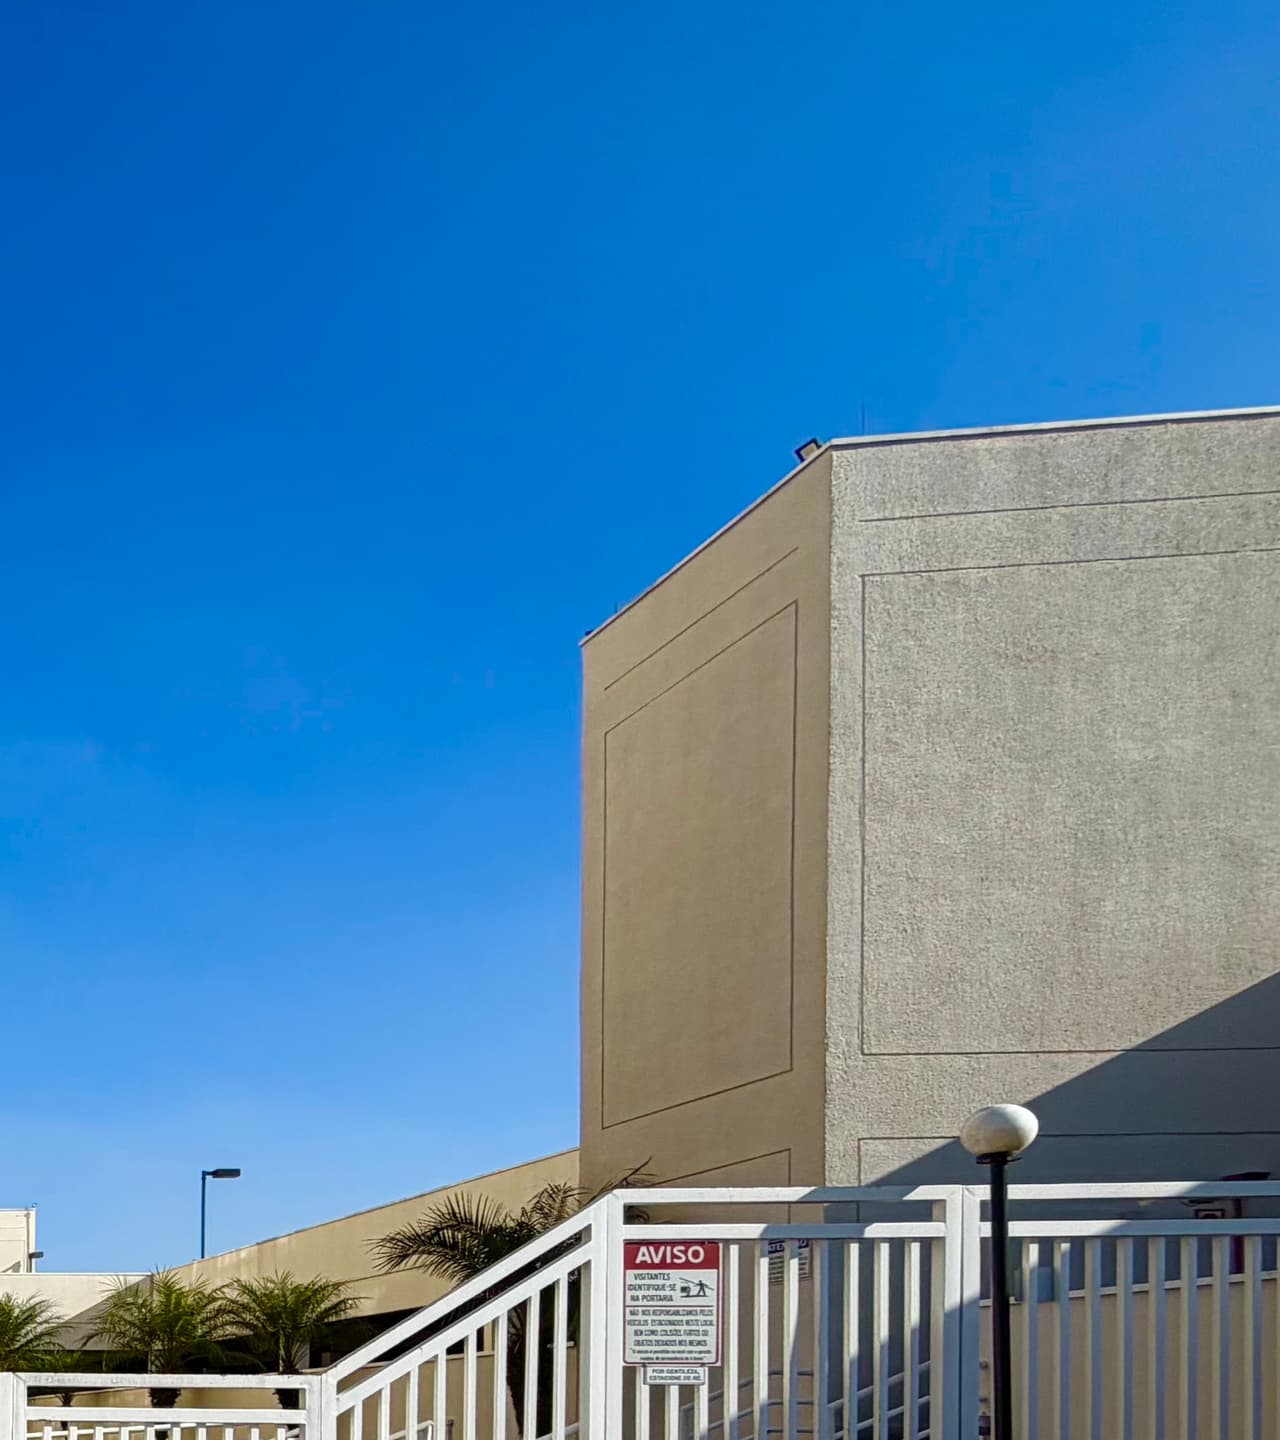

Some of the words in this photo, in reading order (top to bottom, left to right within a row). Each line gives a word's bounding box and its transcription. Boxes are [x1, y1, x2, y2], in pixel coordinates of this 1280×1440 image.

[635, 1245, 705, 1264] AVISO
[633, 1272, 671, 1280] VISITANTES
[627, 1283, 677, 1292] IDENTIFIQUE-SE
[630, 1294, 640, 1302] NA
[641, 1294, 674, 1302] PORTARIA
